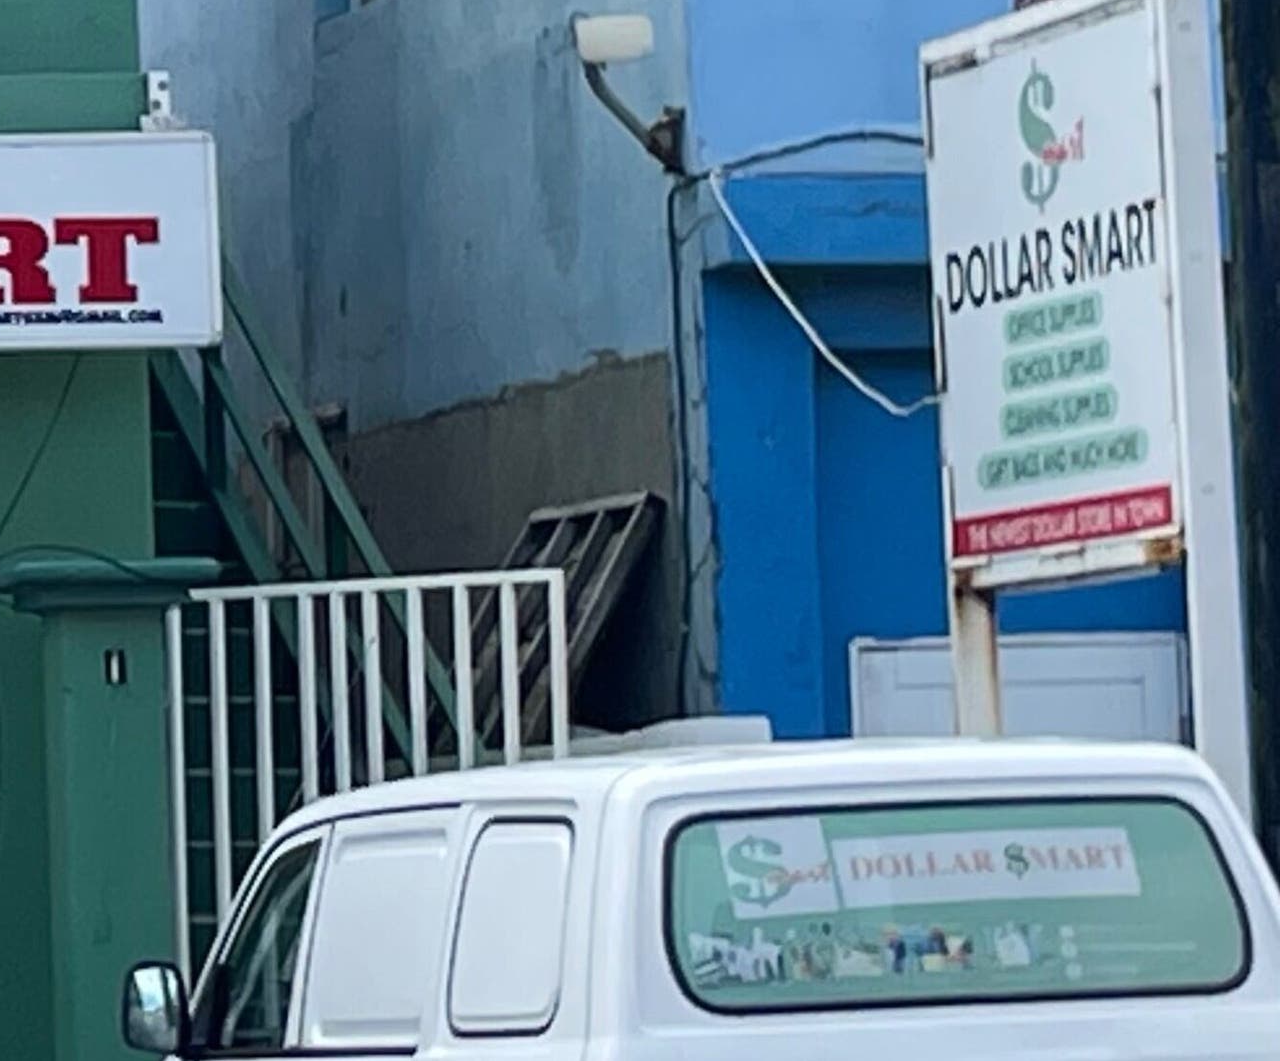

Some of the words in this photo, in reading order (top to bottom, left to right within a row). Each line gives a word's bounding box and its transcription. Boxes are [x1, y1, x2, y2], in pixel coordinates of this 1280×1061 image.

[946, 228, 1055, 314] DOLLAR
[1061, 199, 1157, 285] SMART
[849, 849, 995, 881] DOLLAR
